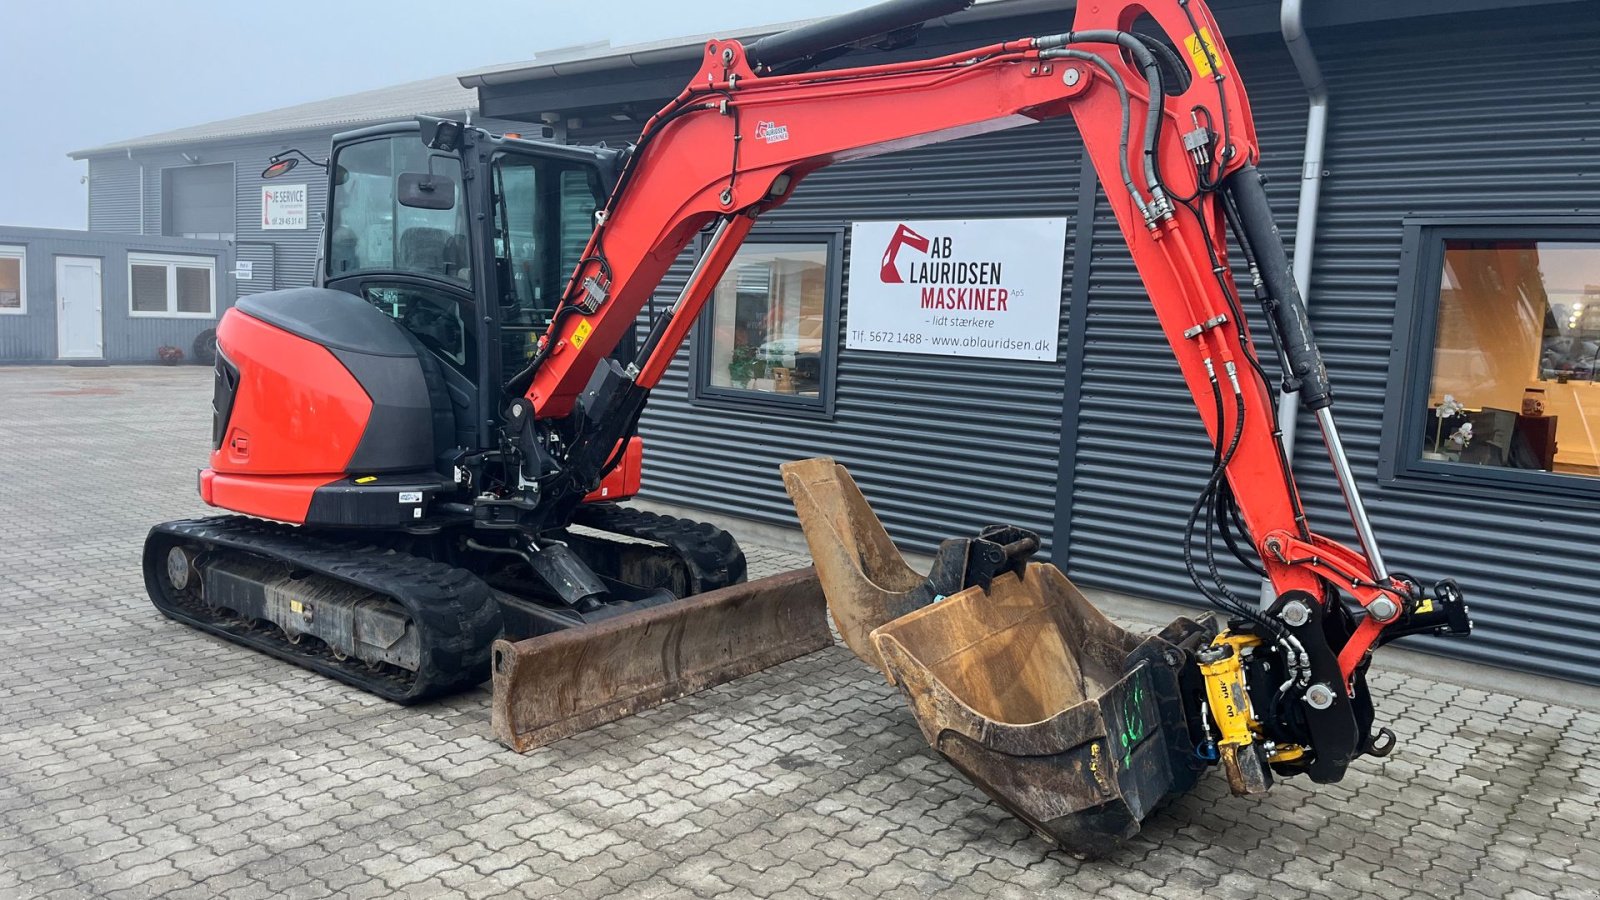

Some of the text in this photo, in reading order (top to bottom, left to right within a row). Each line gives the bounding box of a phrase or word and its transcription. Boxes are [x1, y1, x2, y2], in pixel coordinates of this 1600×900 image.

[272, 190, 303, 203] JE SERVICE
[931, 237, 952, 259] AB
[910, 262, 1001, 285] LAURIDSEN
[921, 287, 1008, 311] MASKINER
[1011, 288, 1024, 297] ApS
[932, 315, 948, 326] lidt
[950, 317, 995, 328] stærkere
[852, 330, 867, 343] Tlf.
[869, 331, 894, 343] 5672
[896, 332, 922, 345] 1488
[931, 336, 1050, 352] www.ablauridsen.dk
